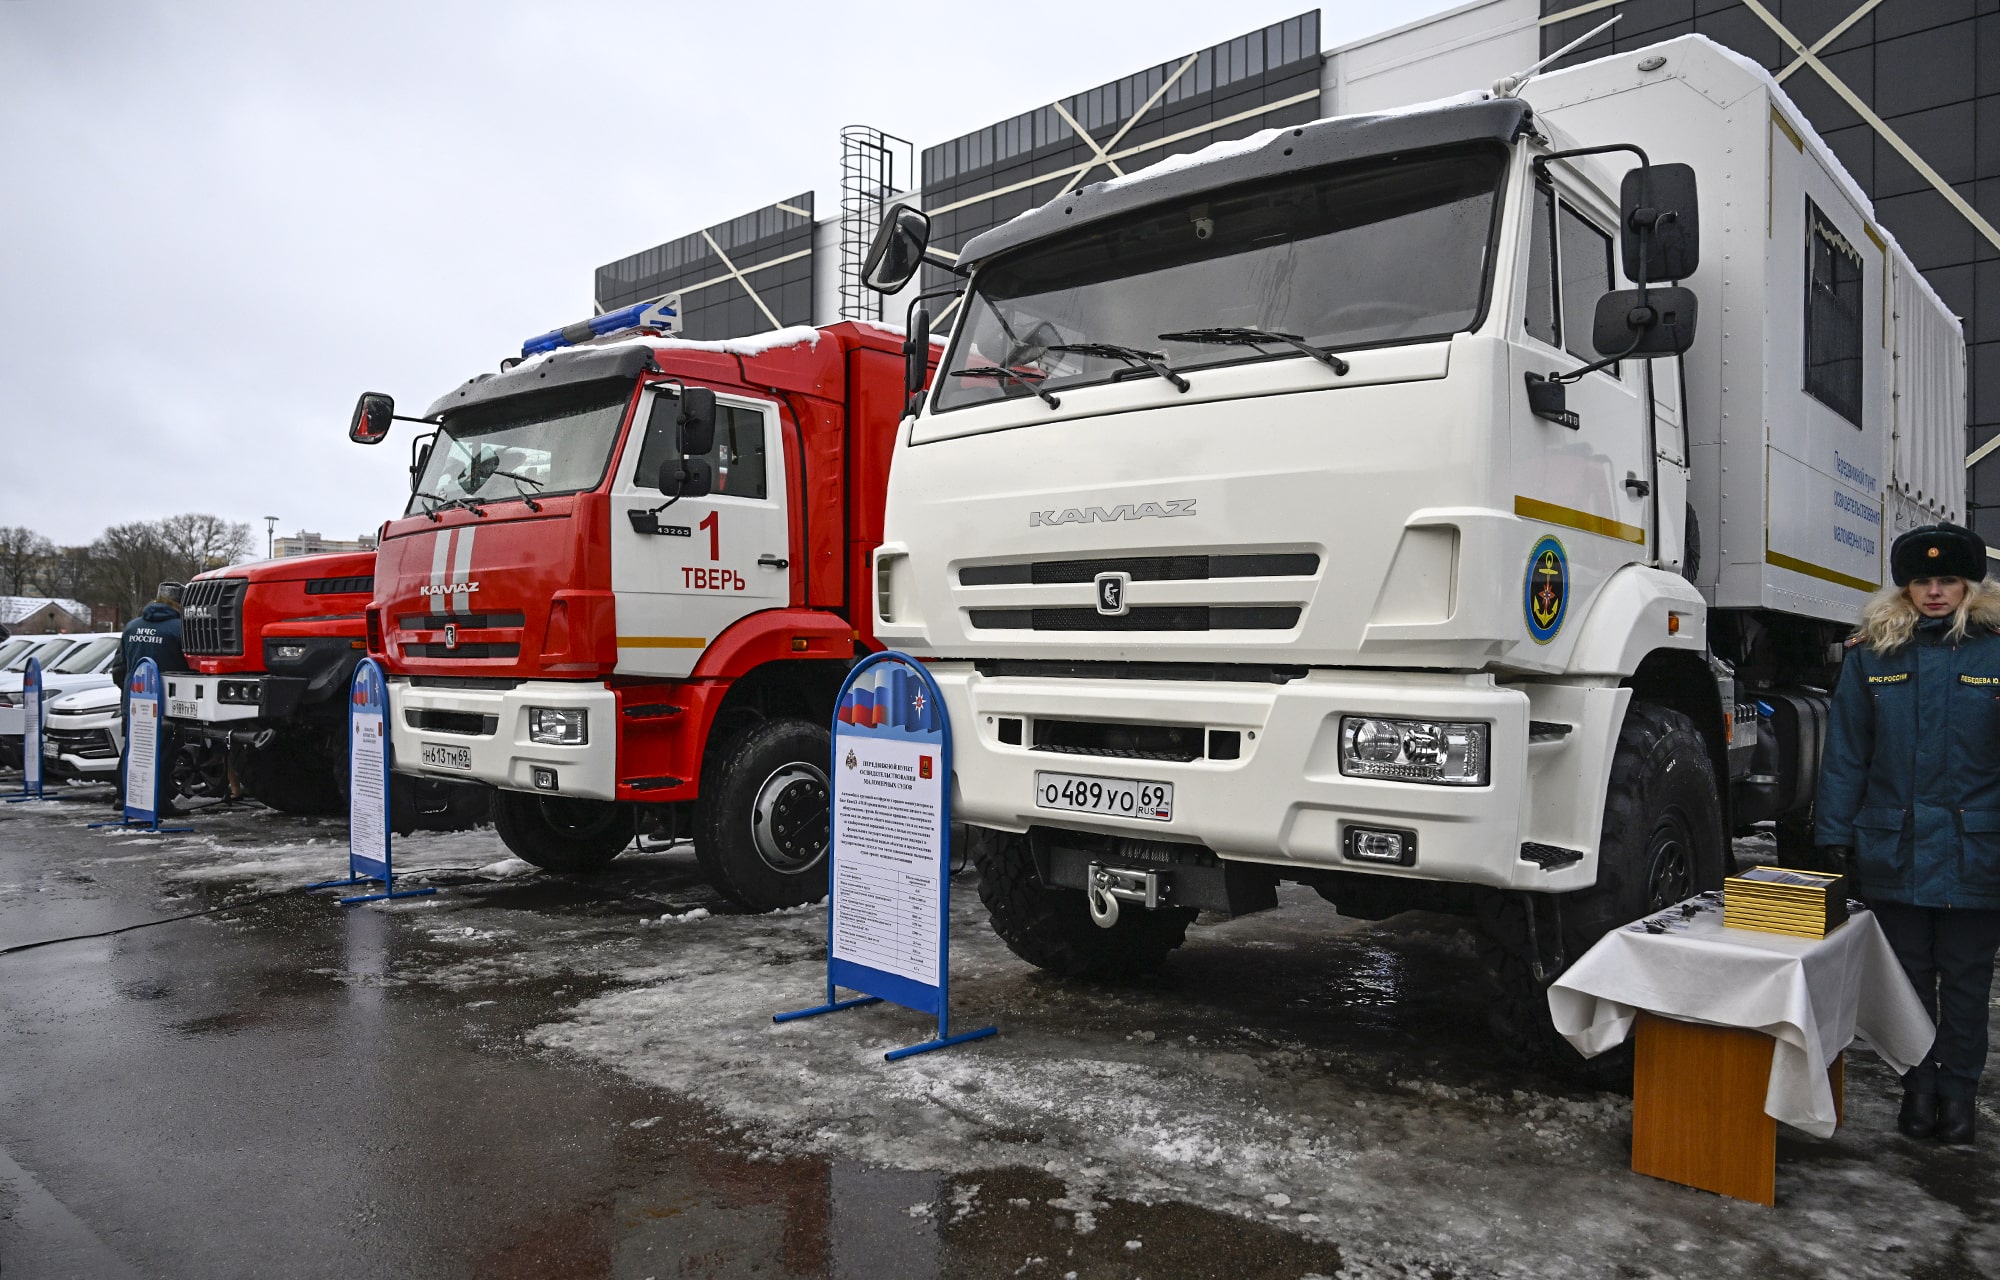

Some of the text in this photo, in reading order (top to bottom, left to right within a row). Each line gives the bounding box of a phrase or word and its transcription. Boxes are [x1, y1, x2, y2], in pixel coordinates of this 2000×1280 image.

[1030, 499, 1196, 527] KAMAZ
[657, 527, 690, 536] 43265
[699, 510, 719, 561] 1
[681, 567, 746, 591] ТВЕРЬ
[420, 582, 479, 596] KAMAZ
[136, 628, 156, 636] МЧС
[129, 635, 162, 643] РОССИИ
[1883, 673, 1907, 682] РОССИИ
[1961, 675, 1991, 685] ЛЕБЕДЕВА
[458, 750, 468, 762] 69
[1141, 785, 1165, 808] 69
[1138, 806, 1155, 815] RUS
